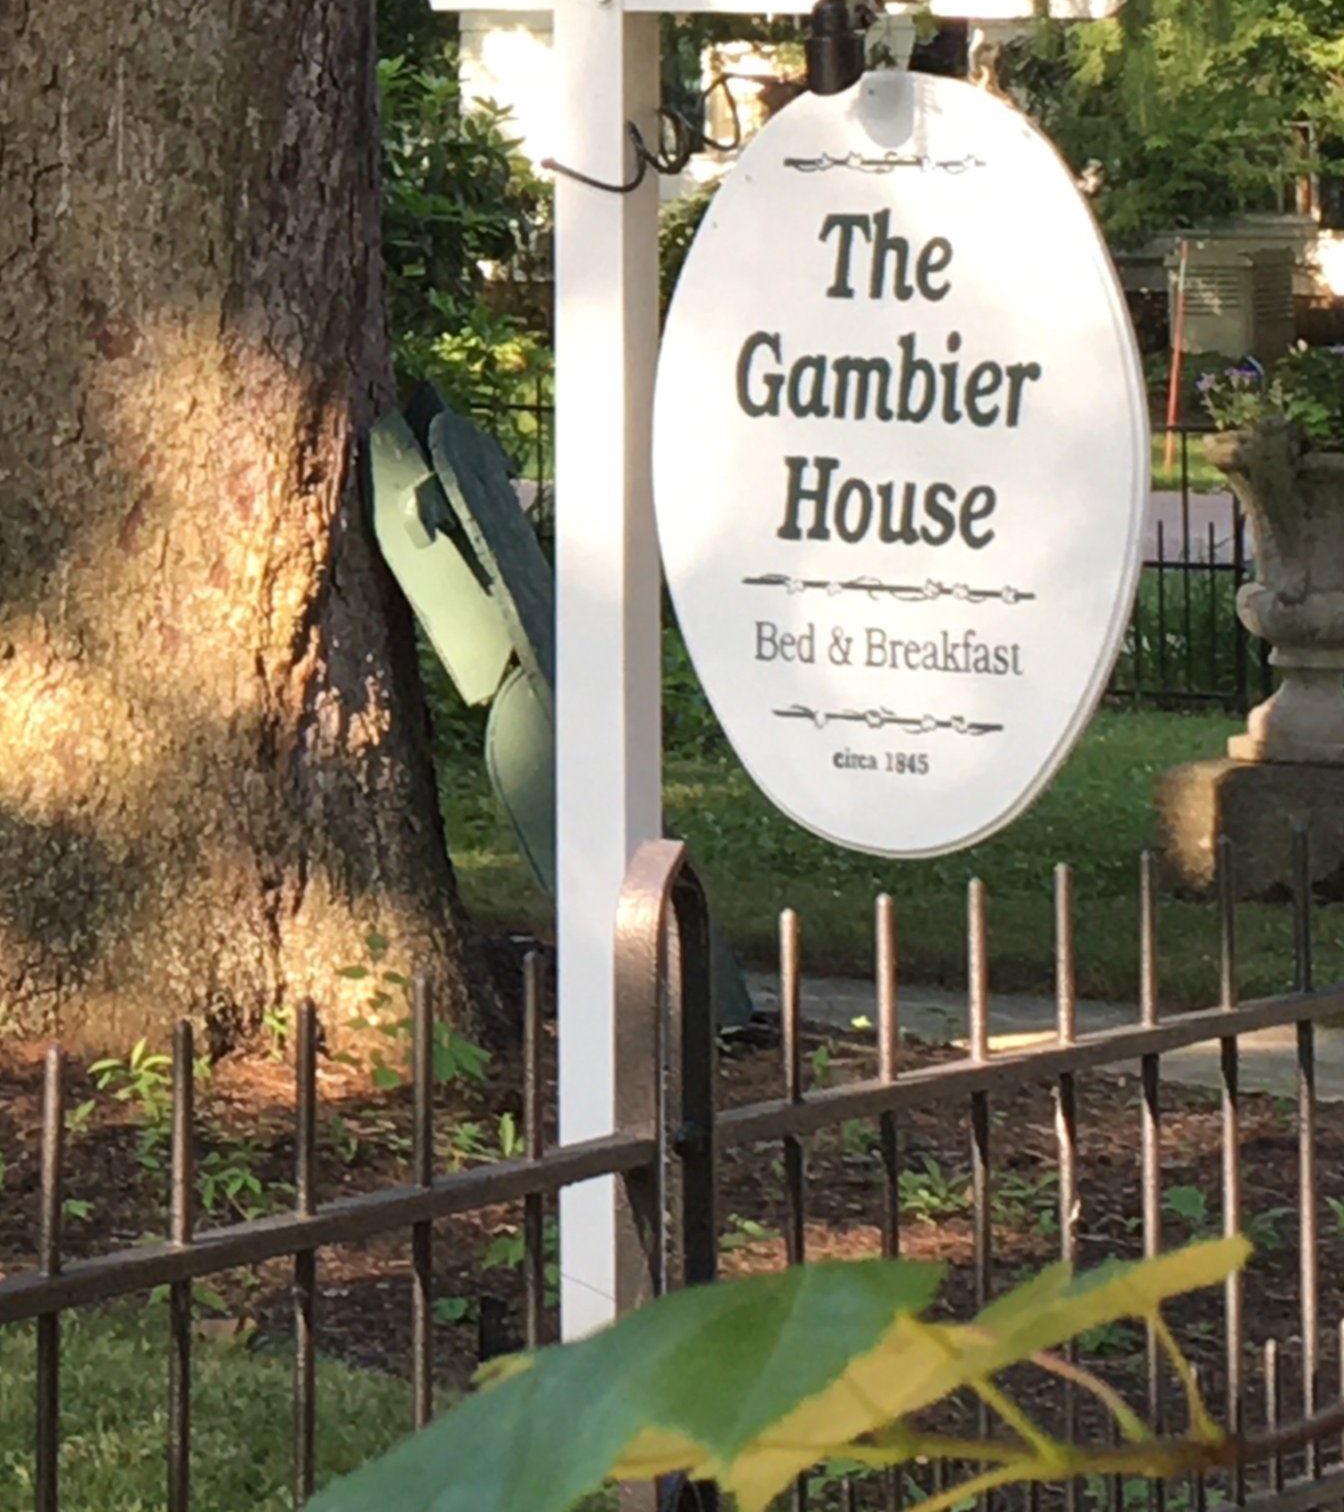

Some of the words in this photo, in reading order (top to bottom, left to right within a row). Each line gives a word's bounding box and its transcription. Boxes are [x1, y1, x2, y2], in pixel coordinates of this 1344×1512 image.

[817, 207, 954, 303] The
[735, 330, 1043, 429] Gambier
[776, 455, 998, 551] House
[754, 620, 815, 664] Bed
[827, 625, 853, 666] &
[864, 627, 1024, 676] Breakfast
[832, 747, 878, 770] circa
[885, 751, 930, 775] 1845
